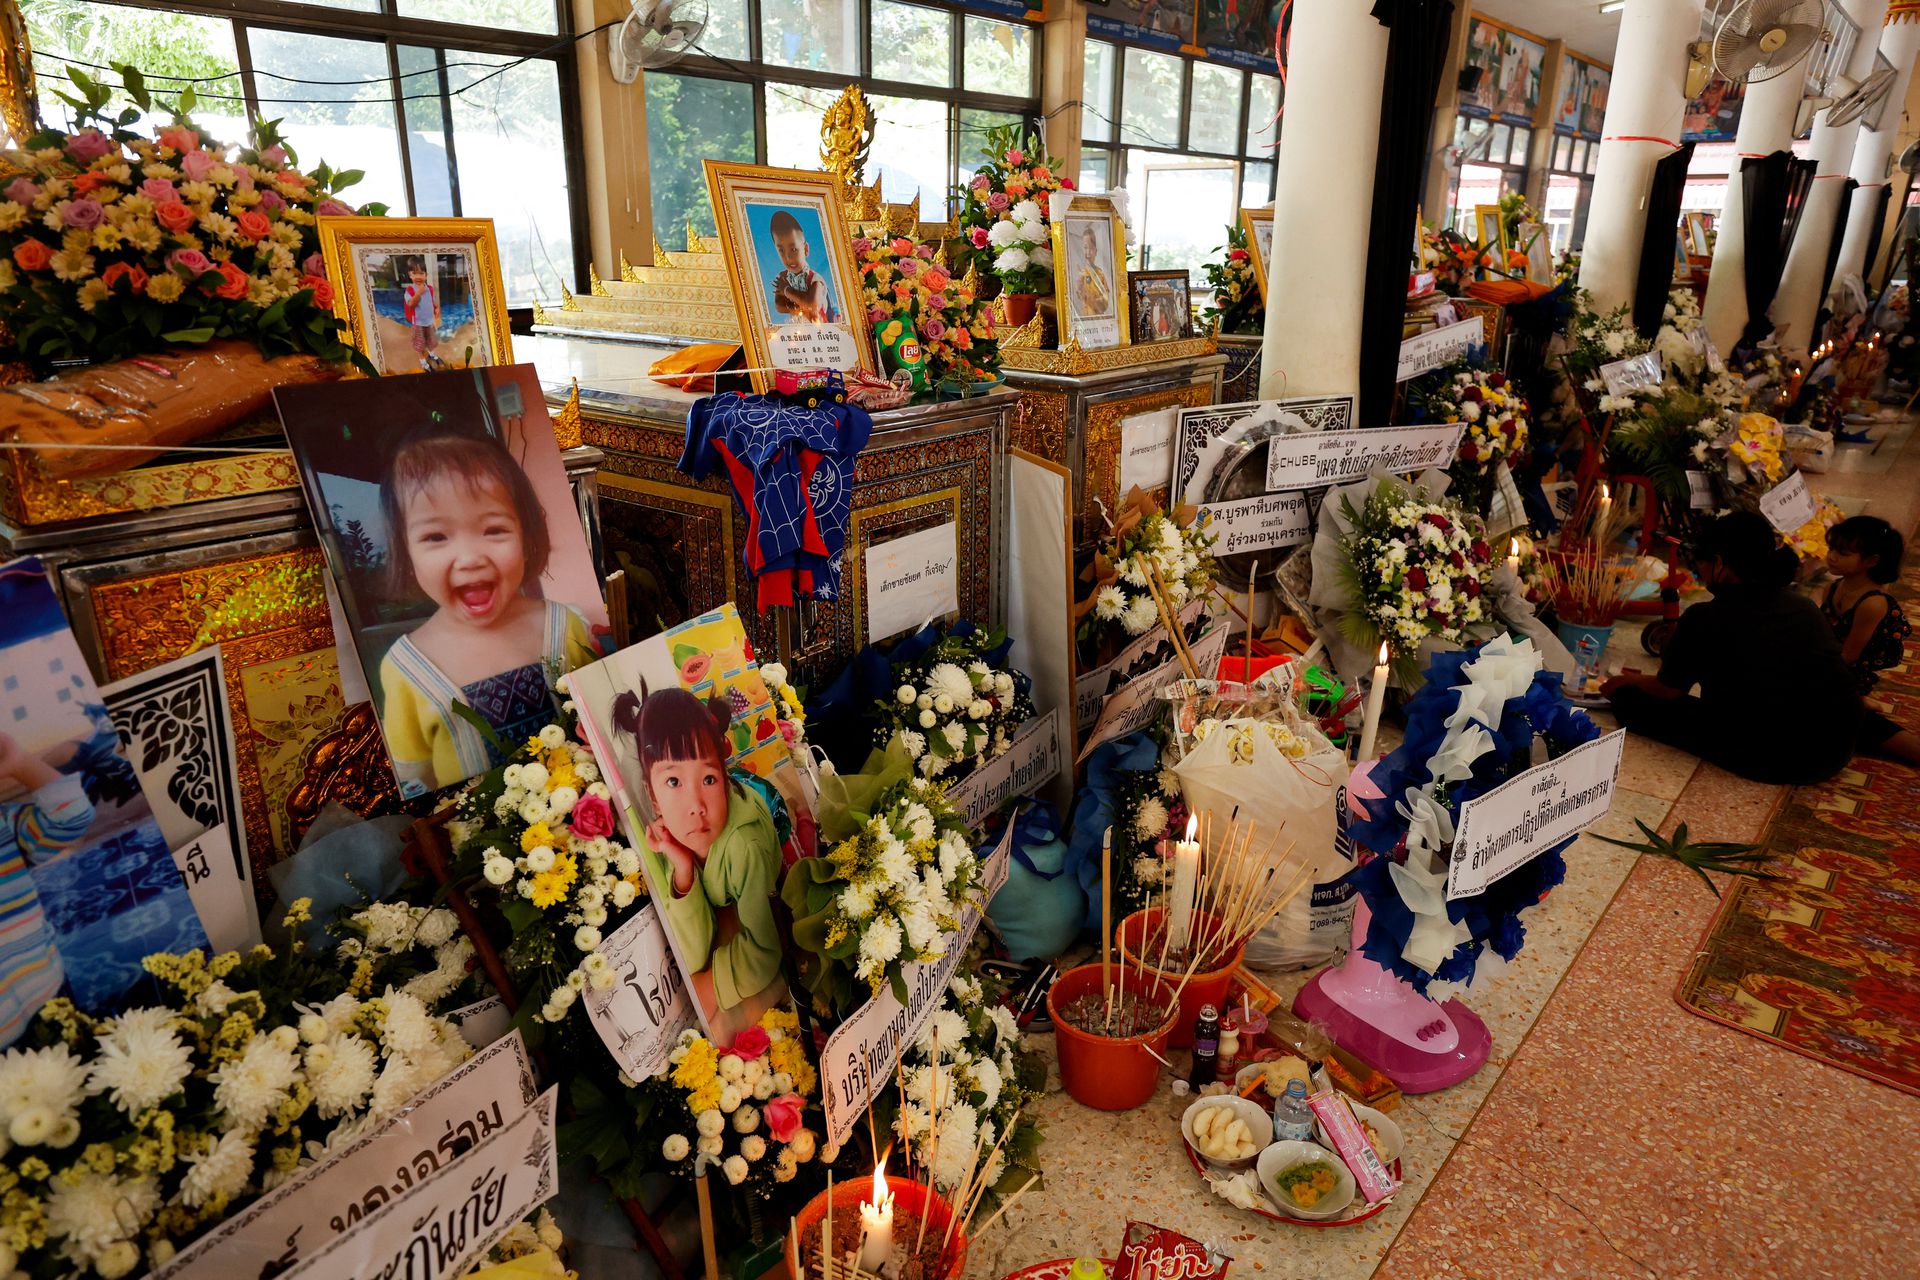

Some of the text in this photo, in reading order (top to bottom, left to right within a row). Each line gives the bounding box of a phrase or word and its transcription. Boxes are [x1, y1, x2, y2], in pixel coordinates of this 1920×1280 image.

[1280, 455, 1317, 469] CHUBB
[1226, 526, 1309, 552] ผู้ร่วมอนุเคราะ
[370, 1166, 508, 1280] ะกันภัย
